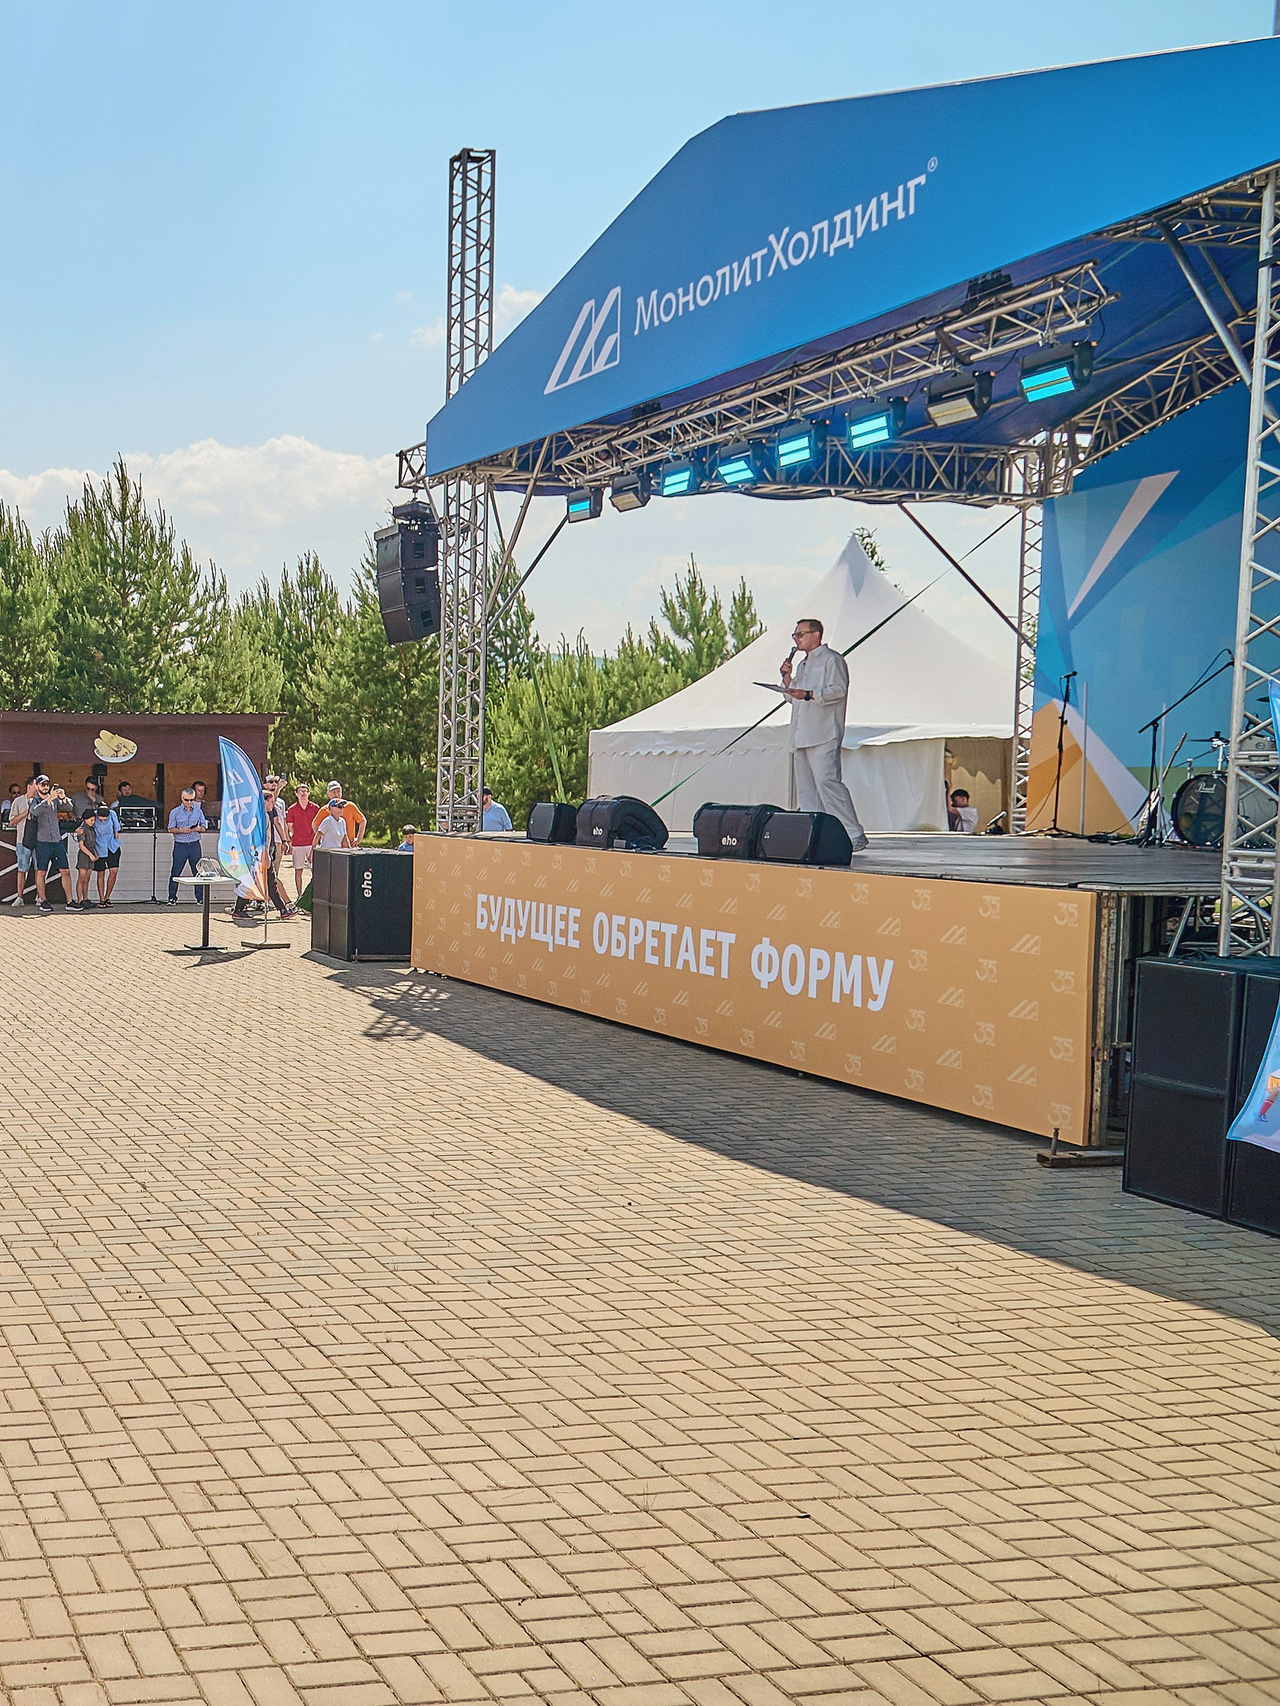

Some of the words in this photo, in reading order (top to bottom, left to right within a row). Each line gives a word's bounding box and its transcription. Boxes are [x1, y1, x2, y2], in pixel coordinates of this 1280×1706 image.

[620, 861, 632, 876] 35
[658, 864, 671, 881] 35
[700, 869, 714, 886] 35
[745, 873, 761, 891] 35
[796, 878, 812, 897] 35
[850, 883, 869, 903] 35
[911, 889, 931, 910] 35
[979, 895, 1001, 918] 35
[1054, 902, 1078, 926] 35
[477, 893, 581, 952] БУДУЩЕЕ
[593, 912, 736, 979] ОБРЕТАЕТ
[751, 937, 895, 1012] ФОРМУ
[907, 949, 927, 970] 35
[975, 958, 997, 980] 35
[1050, 969, 1075, 993] 35
[653, 1007, 666, 1024] 35
[694, 1017, 708, 1035] 35
[906, 1008, 926, 1030] 35
[740, 1028, 755, 1046] 35
[973, 1021, 996, 1044] 35
[790, 1040, 806, 1060] 35
[1049, 1036, 1073, 1060] 35
[844, 1053, 862, 1074] 35
[904, 1068, 924, 1090] 35
[972, 1084, 994, 1107] 35
[1047, 1102, 1072, 1126] 35
